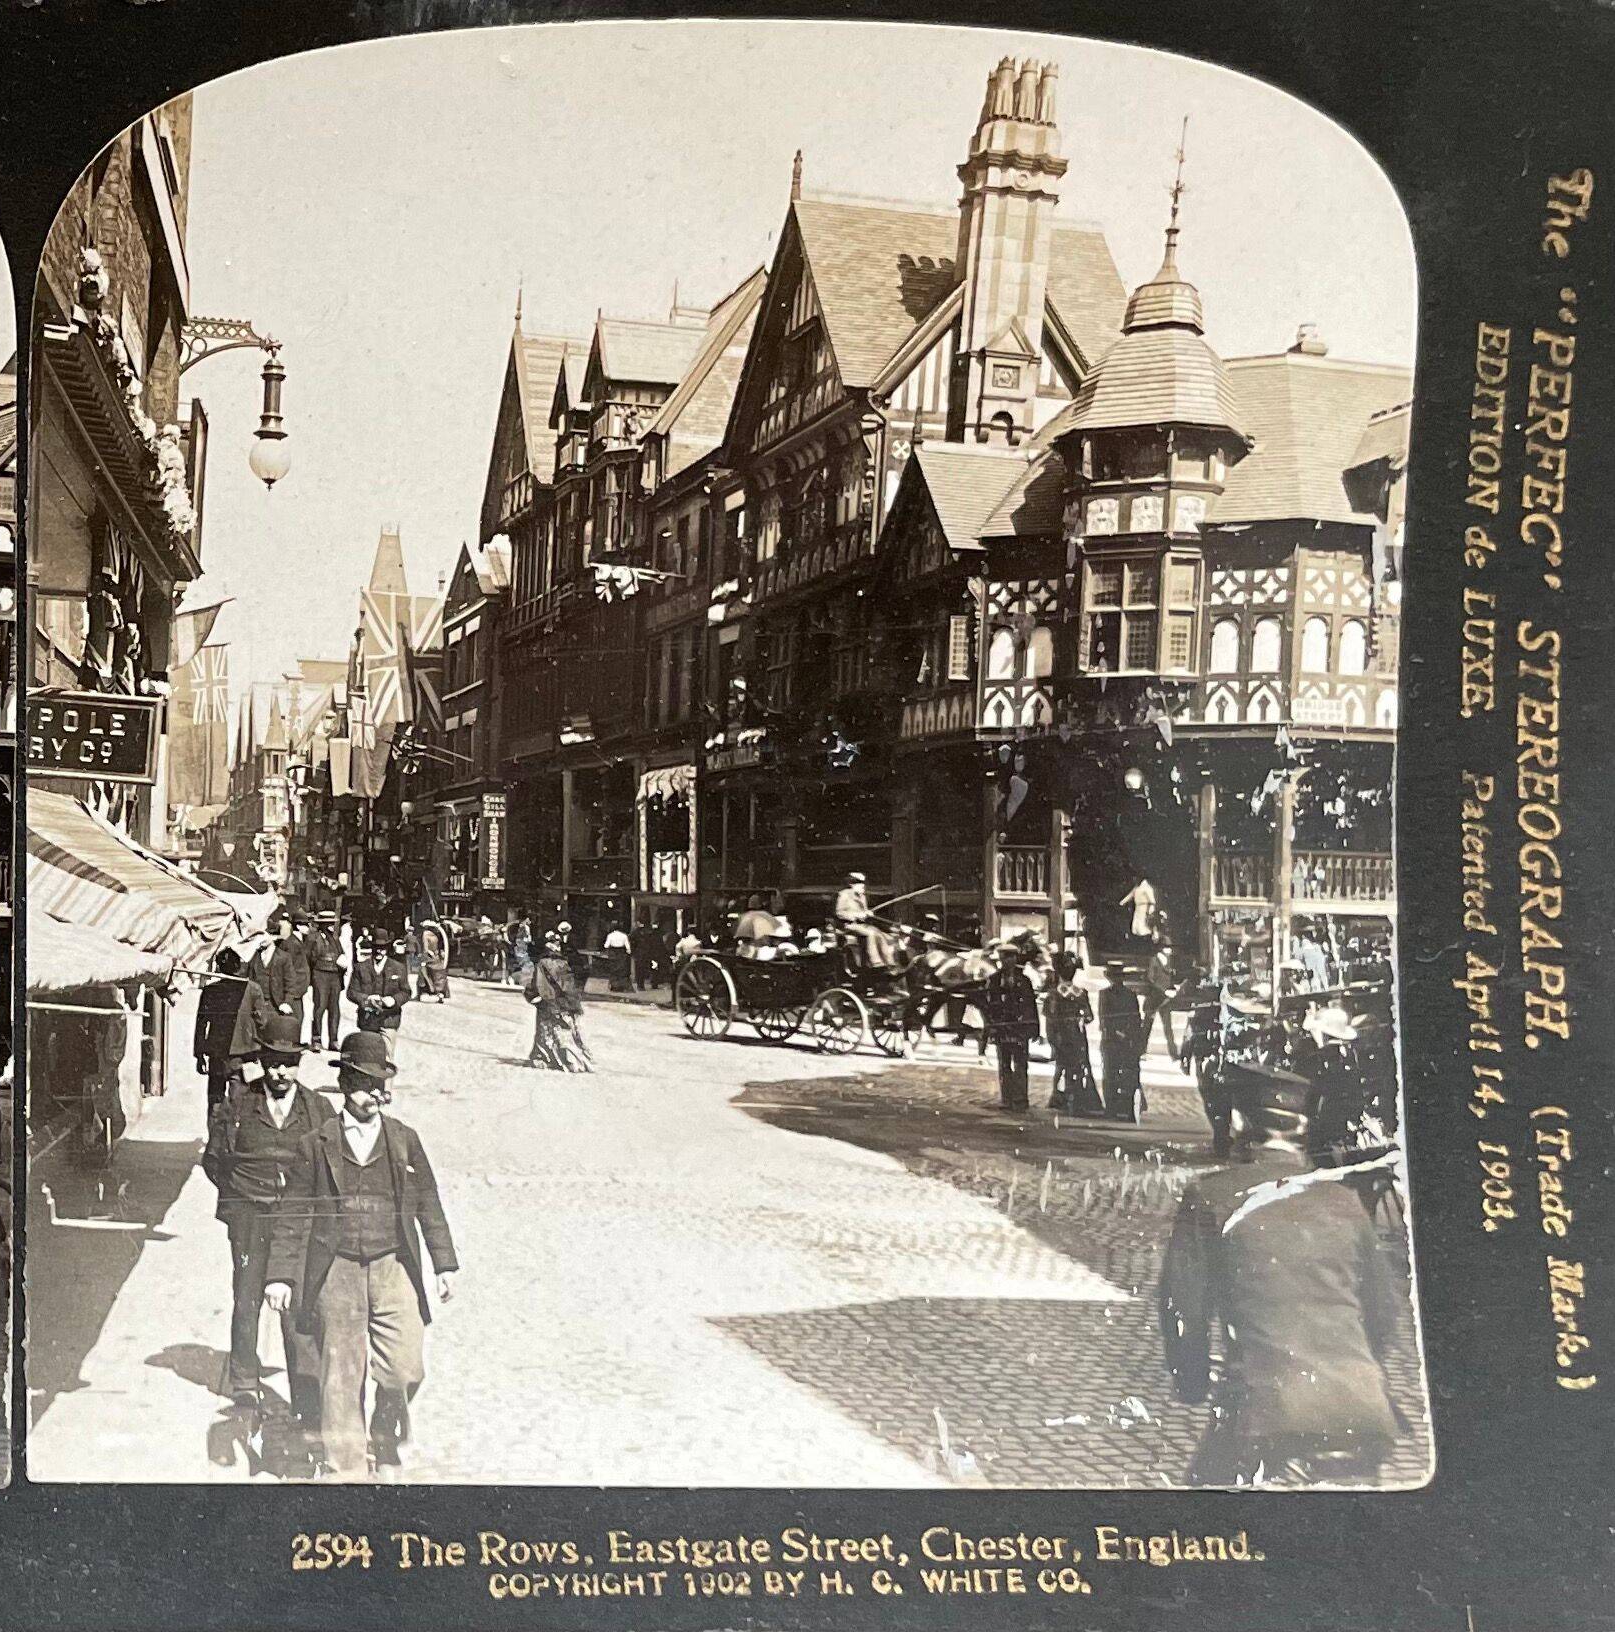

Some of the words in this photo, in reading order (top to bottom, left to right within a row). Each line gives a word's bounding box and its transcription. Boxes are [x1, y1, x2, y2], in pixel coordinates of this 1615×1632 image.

[1543, 168, 1594, 258] The
[1465, 322, 1510, 514] EDITION
[1464, 526, 1496, 568] de
[1460, 587, 1496, 718] LUXE.
[1461, 769, 1497, 935] Patented
[1517, 621, 1570, 1049] STEREOGRAPH.
[1453, 951, 1503, 1052] April
[1469, 1065, 1504, 1118] 14,
[1478, 1140, 1517, 1232] 1903.
[1529, 1106, 1573, 1237] (Trade
[1547, 1255, 1596, 1390] Mark.)
[291, 1533, 373, 1569] 2594
[390, 1532, 466, 1568] The
[607, 1530, 772, 1568] Eastgate
[781, 1526, 909, 1566] Street,
[921, 1526, 1081, 1563] Chester,
[1094, 1526, 1265, 1566] England.
[489, 1572, 668, 1598] COPYRIGHT
[685, 1572, 752, 1597] 1902
[764, 1571, 804, 1597] BY
[819, 1570, 855, 1596] H.
[871, 1570, 904, 1596] C.
[919, 1568, 1026, 1594] WHITE
[1037, 1568, 1092, 1595] CO.
